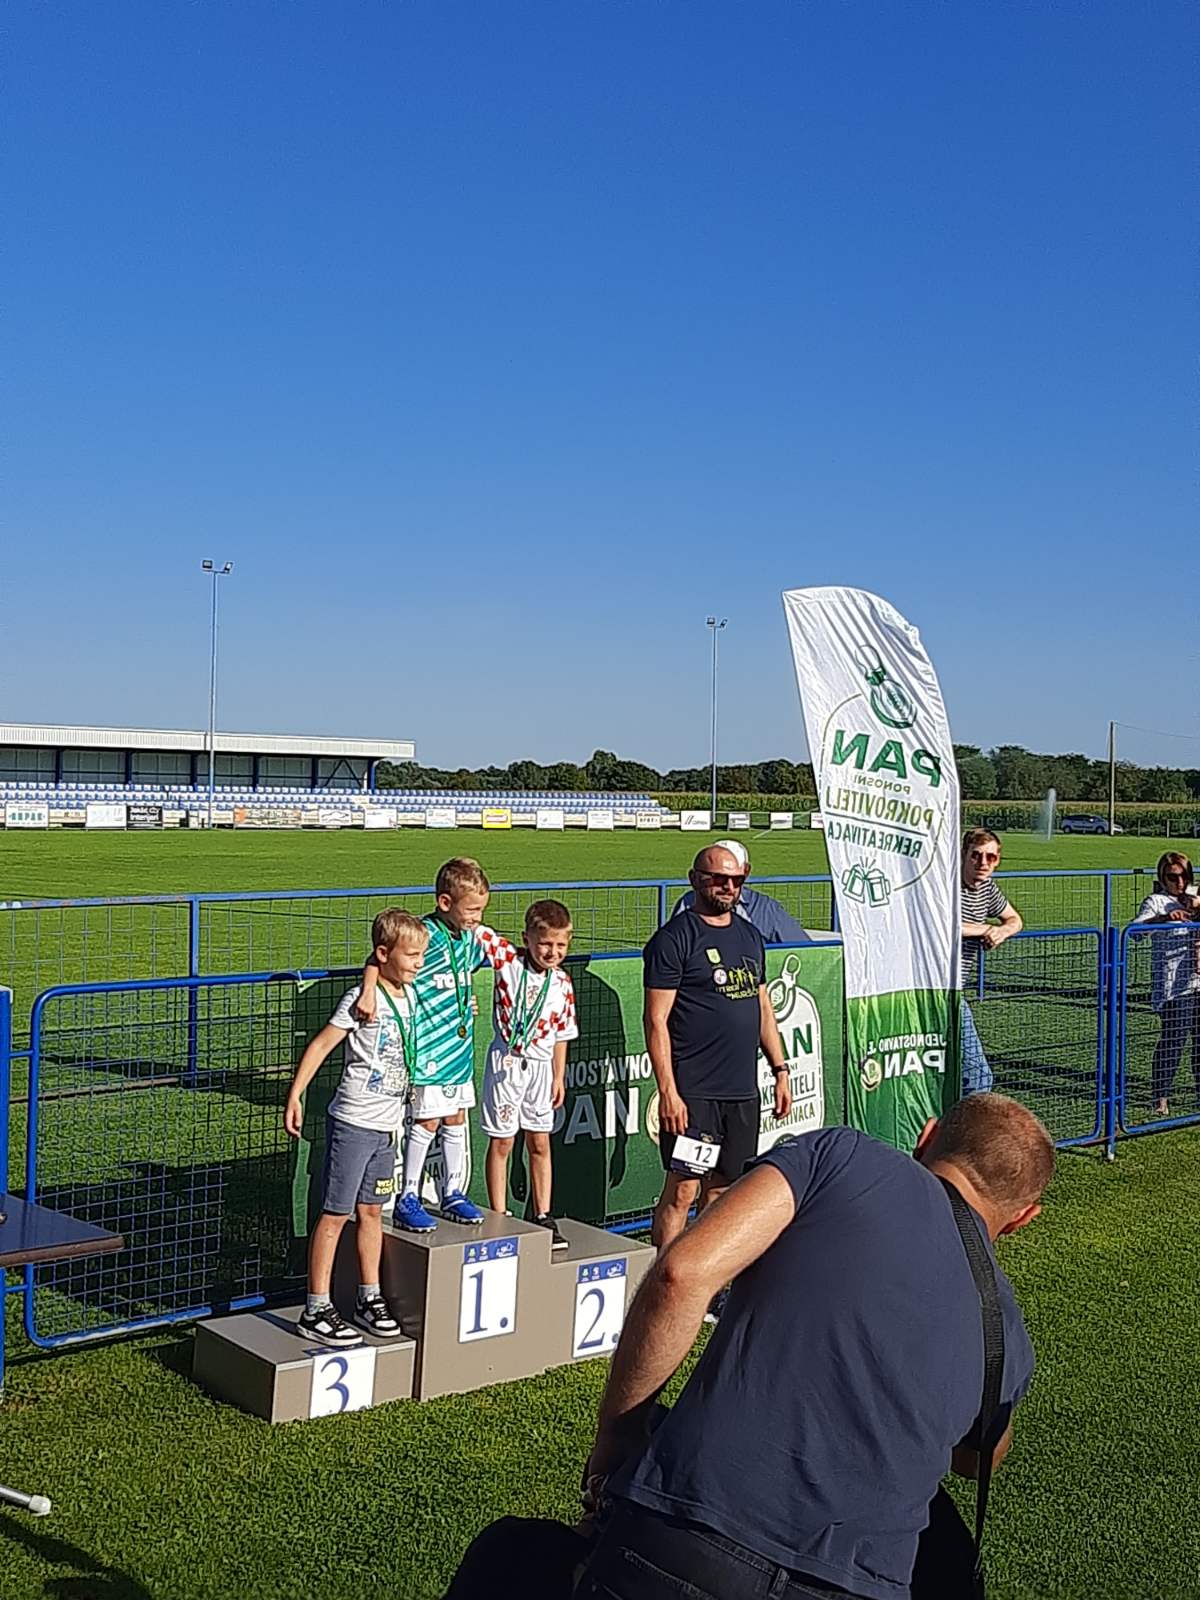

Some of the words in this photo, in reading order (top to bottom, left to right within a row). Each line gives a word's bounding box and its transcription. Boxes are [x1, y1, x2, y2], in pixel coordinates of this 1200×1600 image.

[694, 1144, 713, 1164] 12
[466, 1268, 509, 1335] 1.
[577, 1287, 620, 1351] 2.
